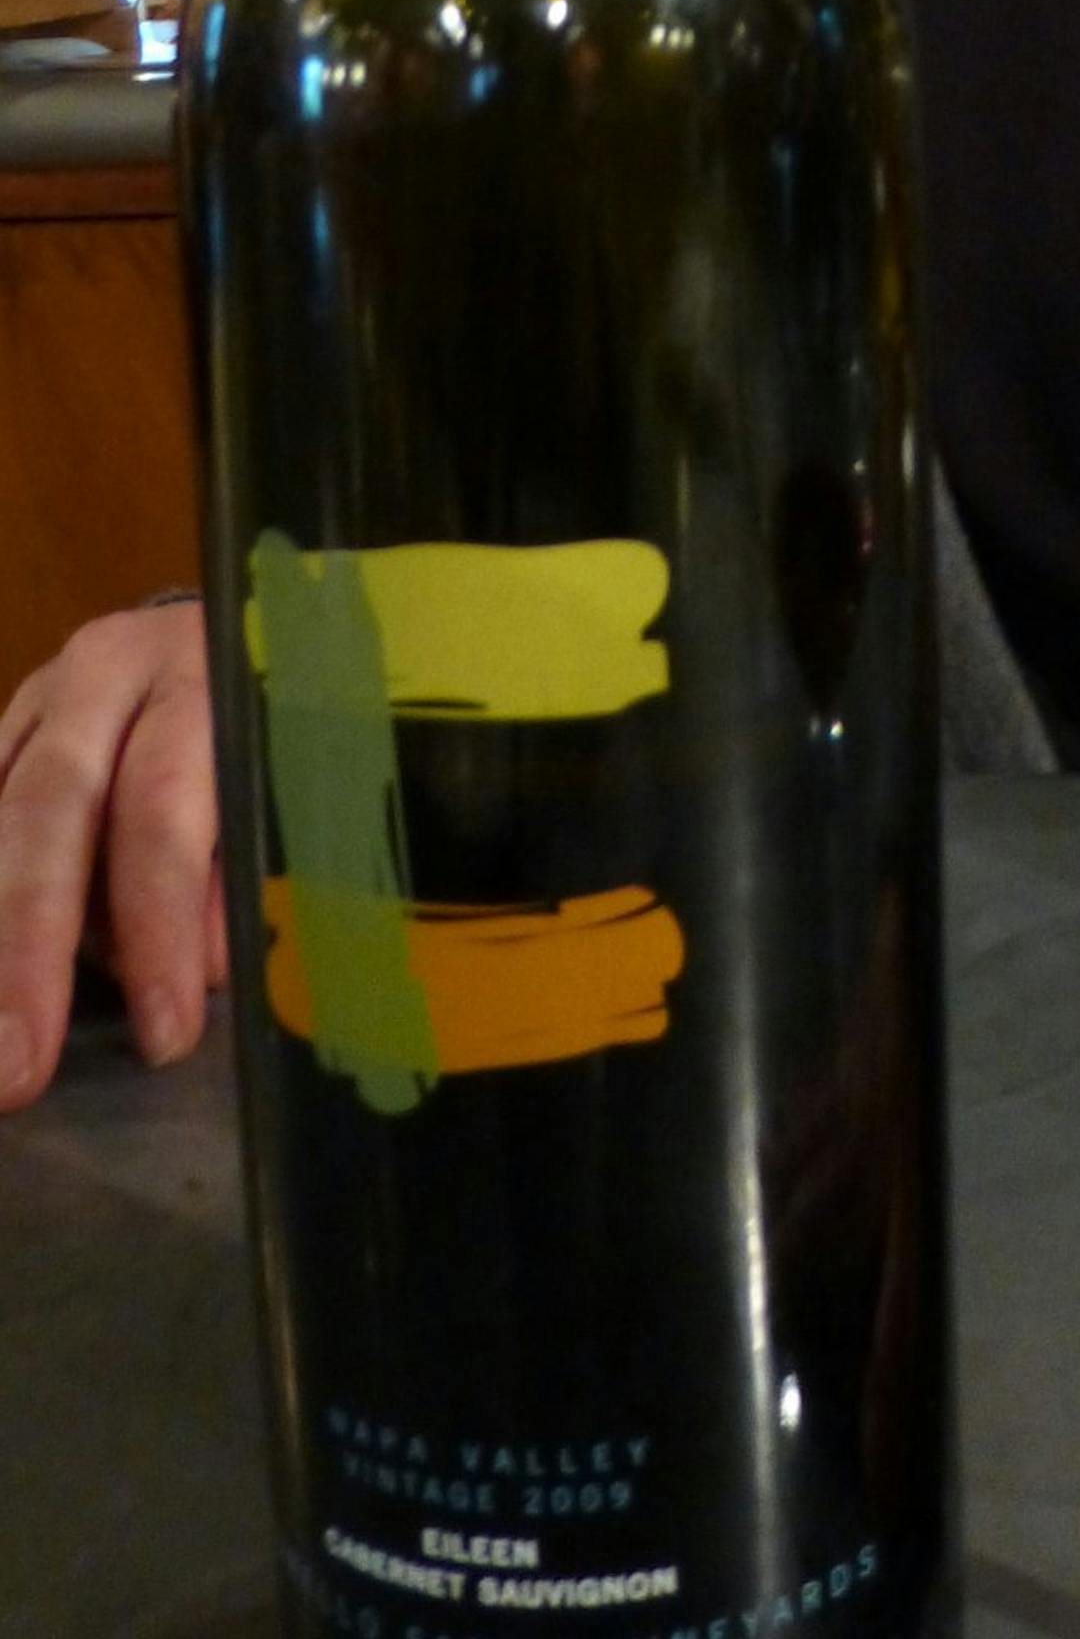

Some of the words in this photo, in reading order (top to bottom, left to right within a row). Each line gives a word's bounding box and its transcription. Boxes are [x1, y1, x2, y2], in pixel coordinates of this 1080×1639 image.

[328, 1405, 427, 1461] NAPA
[459, 1435, 649, 1476] VALLEY
[344, 1450, 497, 1513] VINTAGE
[523, 1479, 633, 1515] 2009
[324, 1526, 467, 1601] CABERNET
[477, 1565, 680, 1610] SAUVIGNON
[422, 1526, 540, 1569] EILEEN
